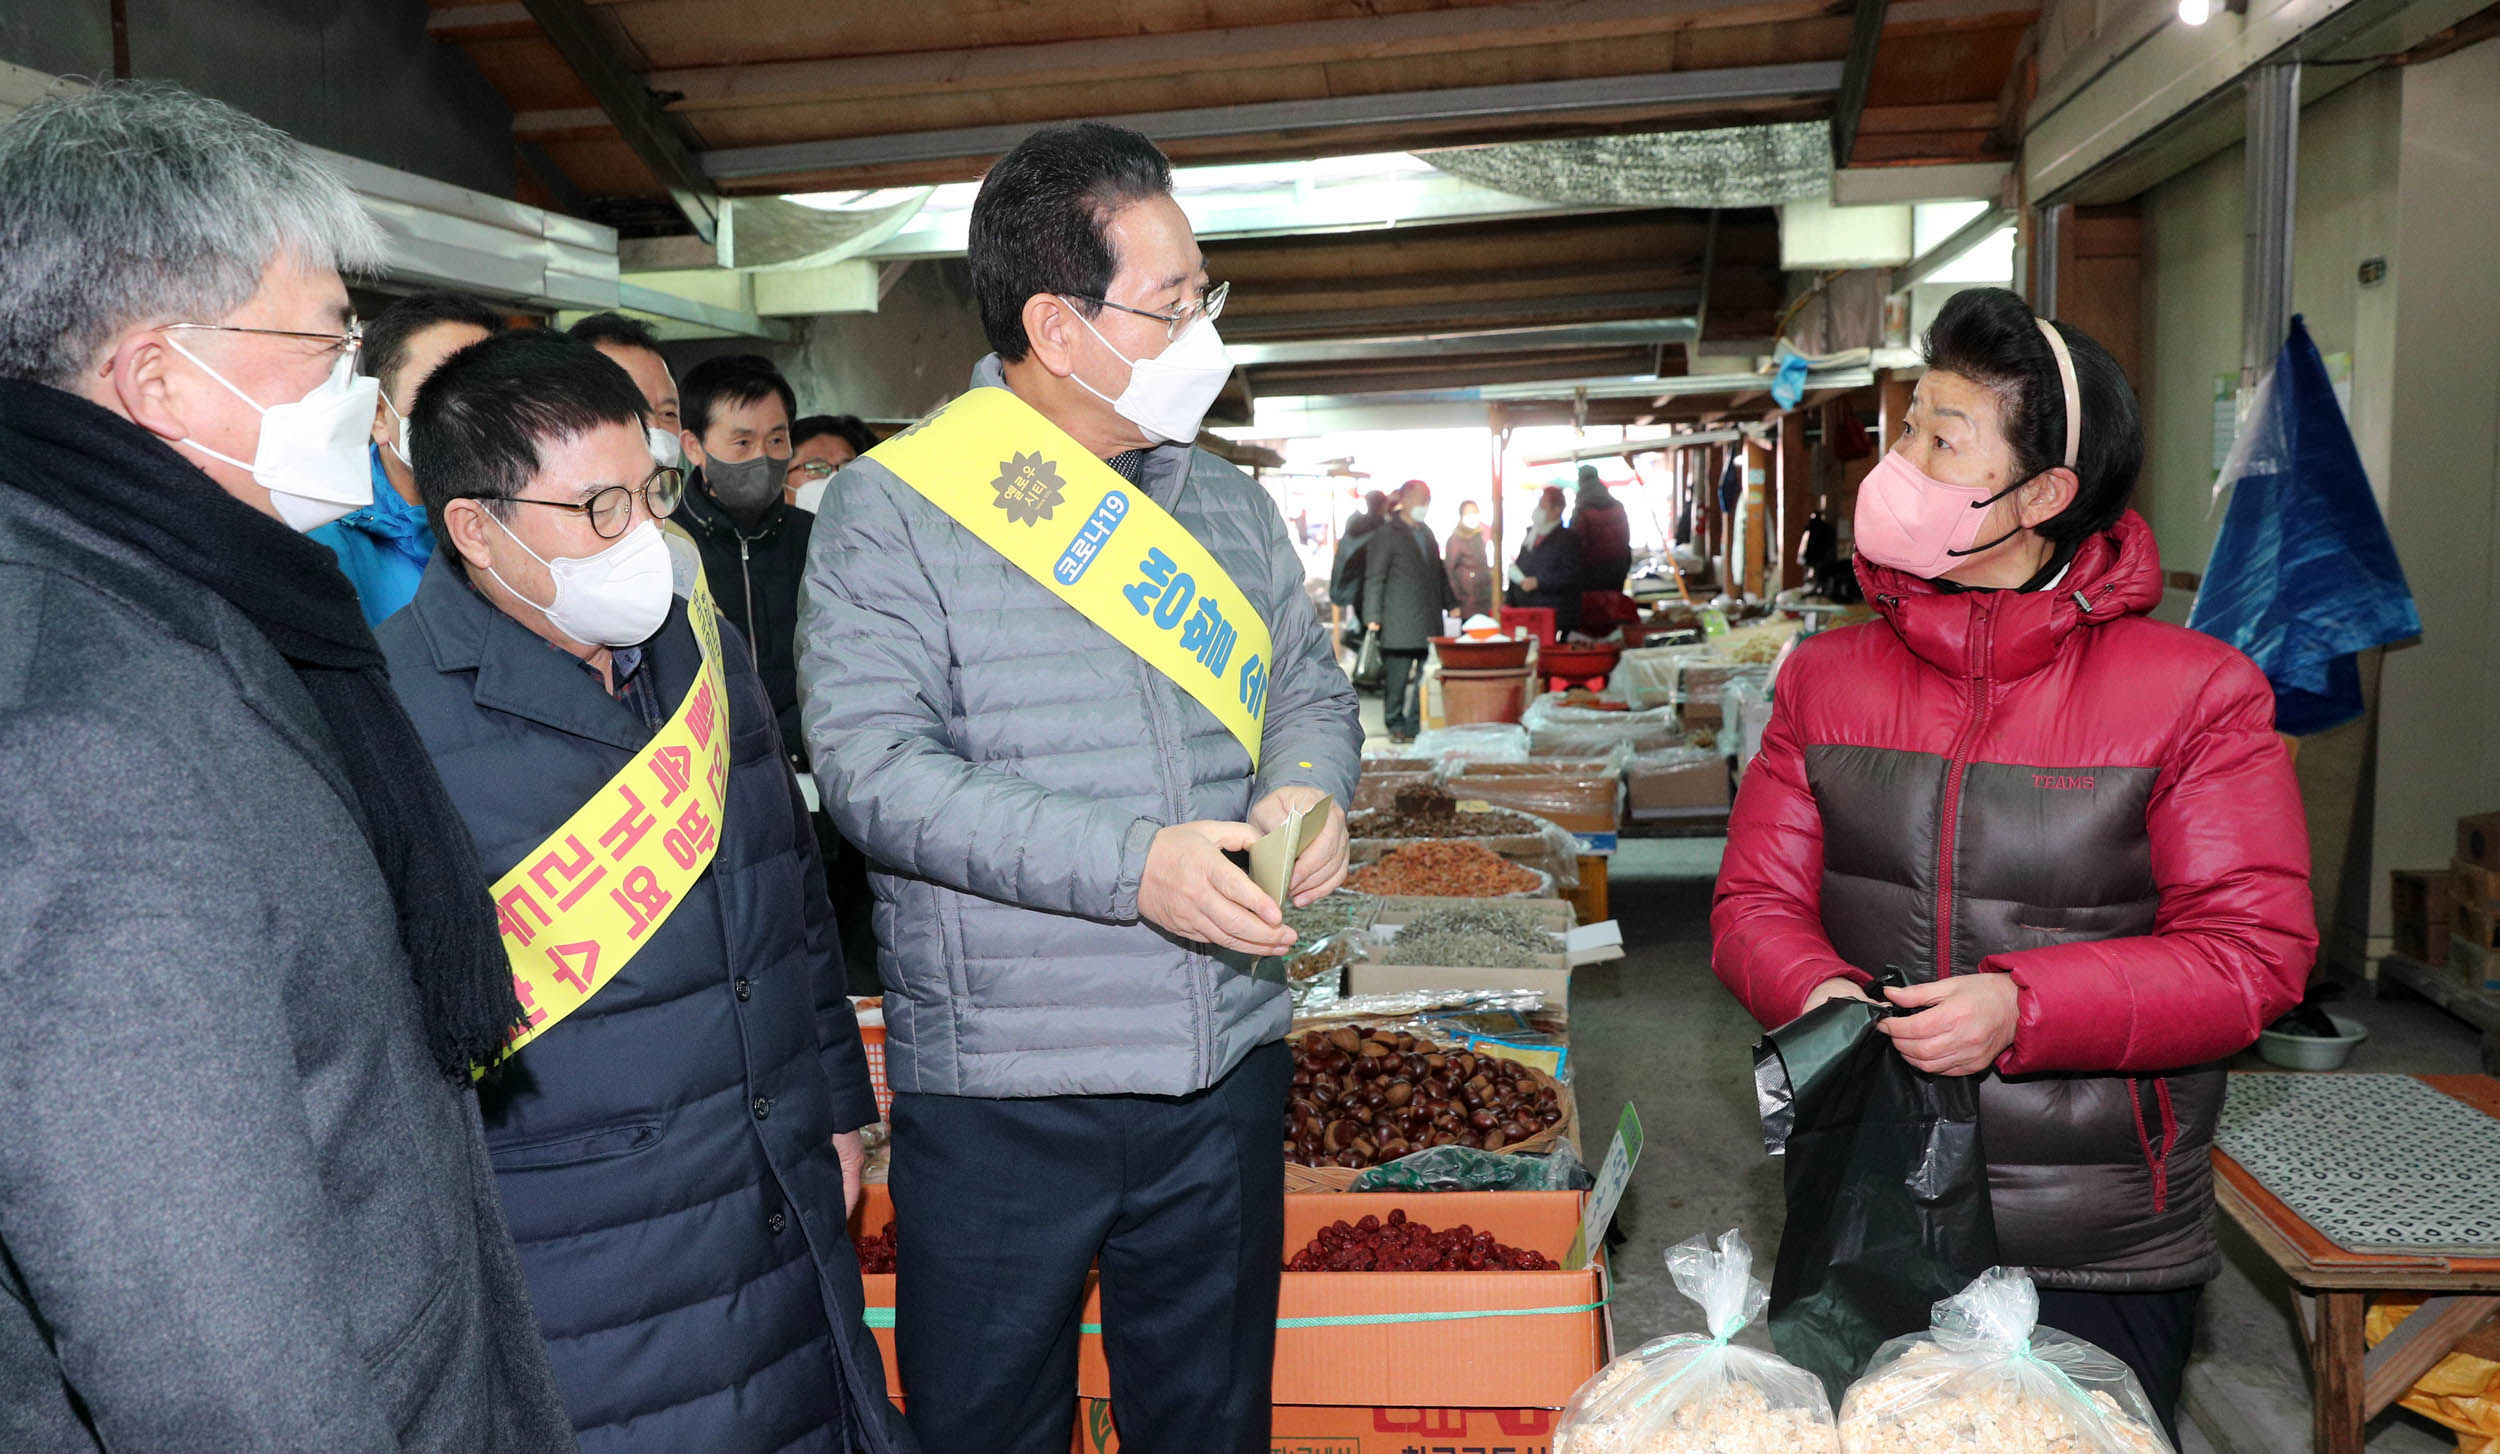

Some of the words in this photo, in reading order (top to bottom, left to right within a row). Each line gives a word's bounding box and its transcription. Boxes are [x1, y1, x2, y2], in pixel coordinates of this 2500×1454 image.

[1004, 465, 1036, 501] 옐로우
[1024, 480, 1048, 507] 시티
[1058, 495, 1125, 583] 코로나19
[1122, 546, 1238, 679] 생활
[2031, 773, 2096, 791] TEAMS
